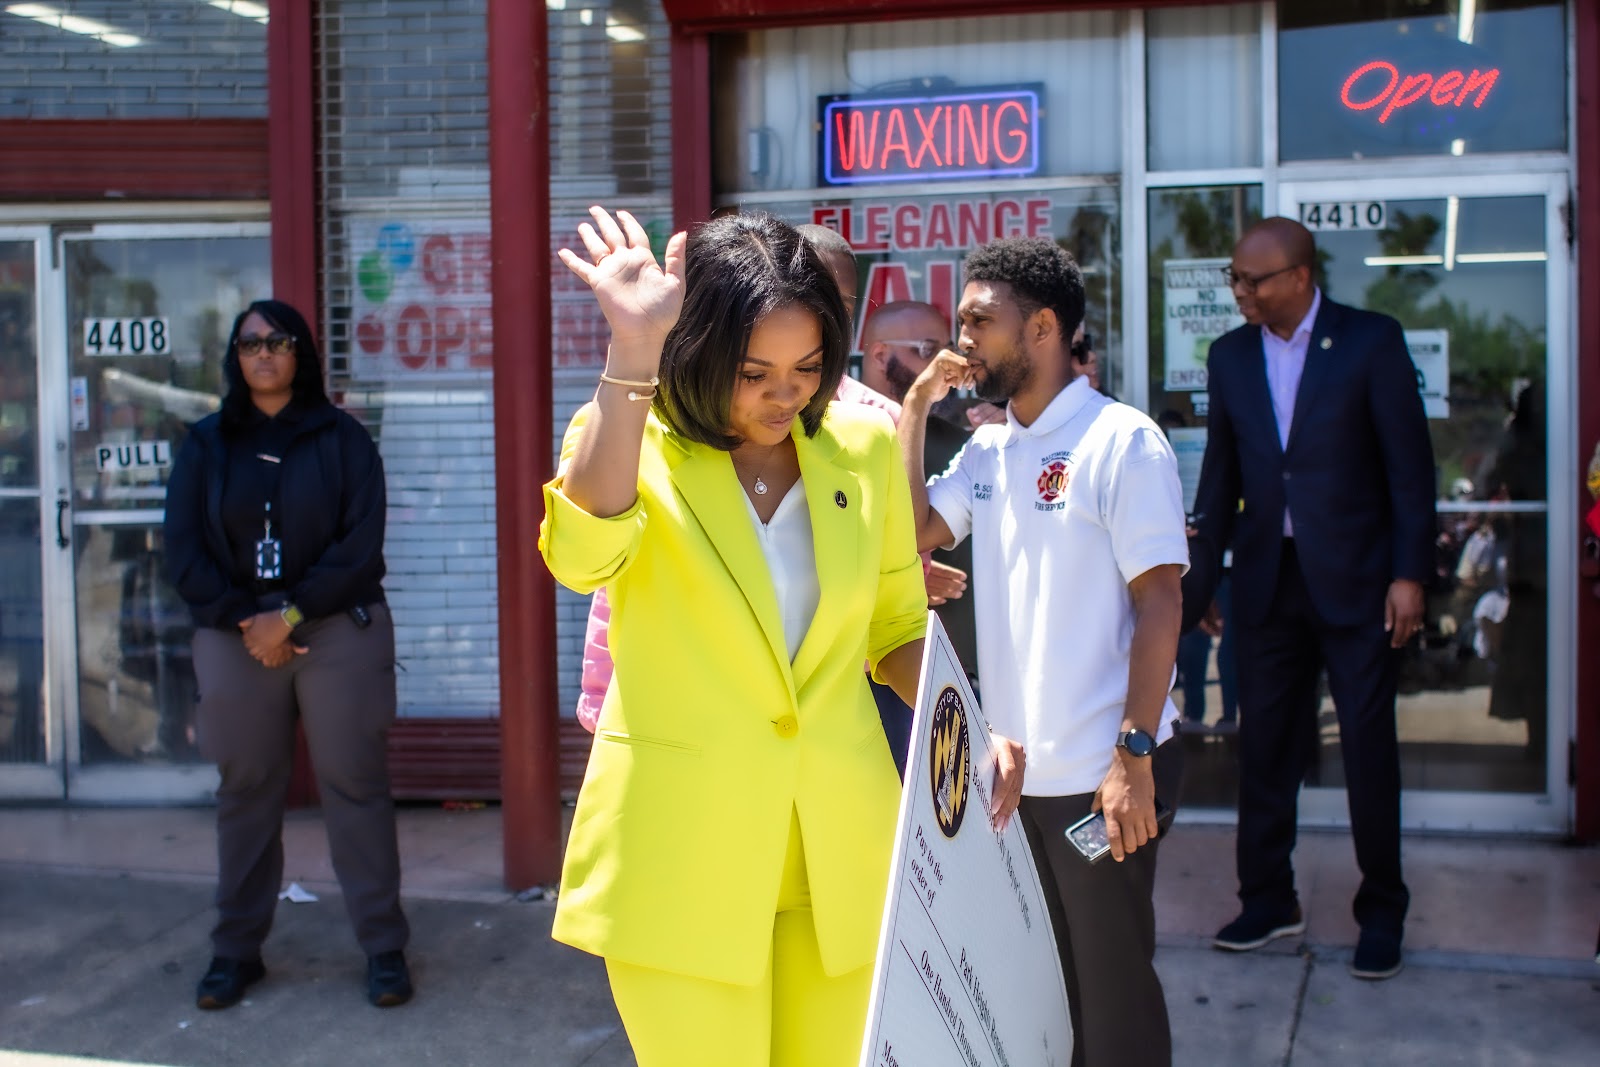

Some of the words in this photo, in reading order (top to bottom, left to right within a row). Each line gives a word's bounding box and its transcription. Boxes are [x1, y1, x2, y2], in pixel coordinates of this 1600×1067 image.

[1340, 60, 1500, 124] Open
[836, 100, 1029, 171] WAXING
[1307, 203, 1383, 229] 4410
[1197, 289, 1216, 301] NO
[87, 320, 166, 353] 4408
[99, 445, 167, 469] PULL
[935, 697, 947, 722] CITY
[946, 692, 955, 703] OF
[954, 696, 970, 787] BALTIMORE
[915, 823, 928, 857] Pay
[927, 849, 934, 867] to
[933, 862, 944, 886] the
[911, 859, 928, 890] order
[927, 889, 937, 909] of
[921, 950, 934, 983] One
[933, 972, 959, 1030] Hundred
[960, 947, 973, 990] Park
